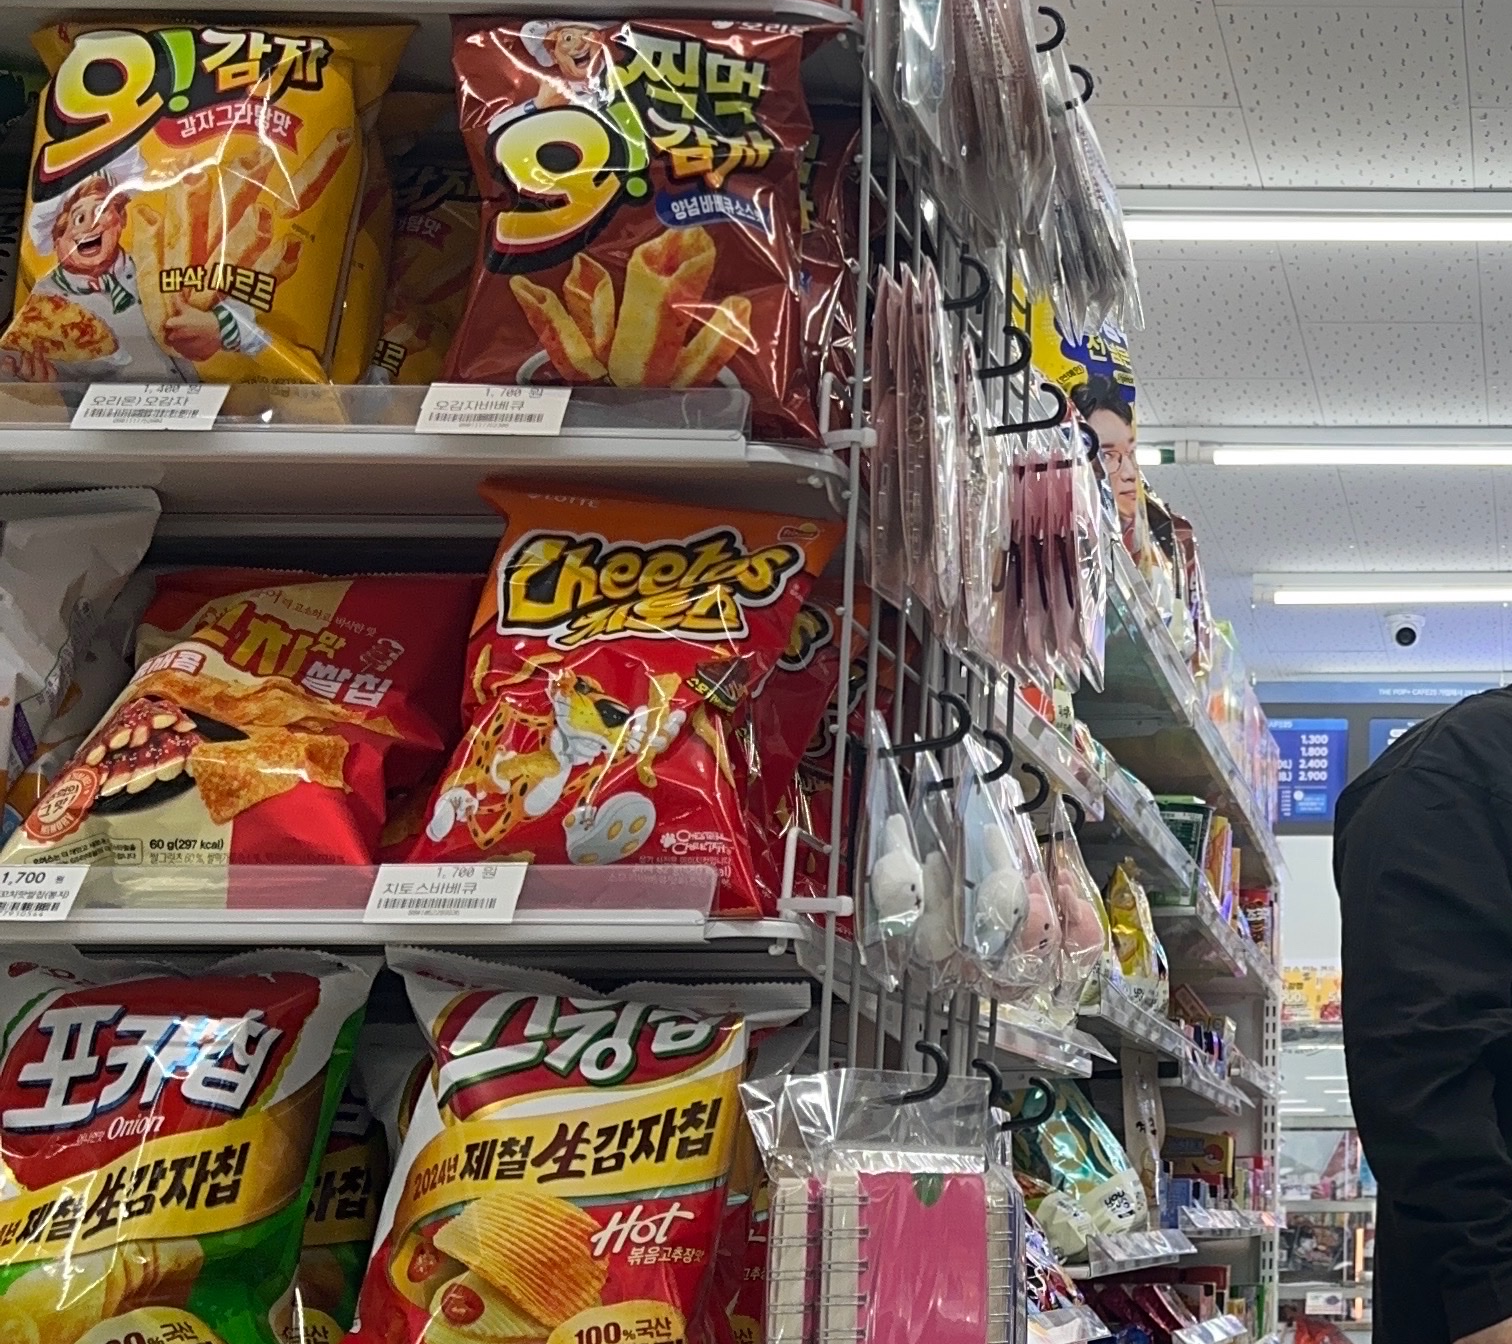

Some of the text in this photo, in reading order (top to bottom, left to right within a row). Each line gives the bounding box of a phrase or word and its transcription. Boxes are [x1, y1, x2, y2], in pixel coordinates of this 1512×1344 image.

[611, 32, 766, 123] 찍먹
[176, 99, 293, 140] 감자그라탕맛
[647, 107, 776, 189] 감자
[160, 263, 277, 311] 바삭 사르르
[505, 536, 797, 626] Cheetos
[149, 839, 225, 851] 60 g(297 kcal)
[4, 1002, 282, 1132] 포카칩
[106, 1112, 165, 1141] Onion
[413, 1099, 722, 1203] 2024년 제철 生감자칩
[84, 1142, 251, 1243] 生감자칩
[591, 1203, 696, 1257] Hot
[165, 1323, 199, 1344] 국산
[636, 1317, 672, 1341] 국산
